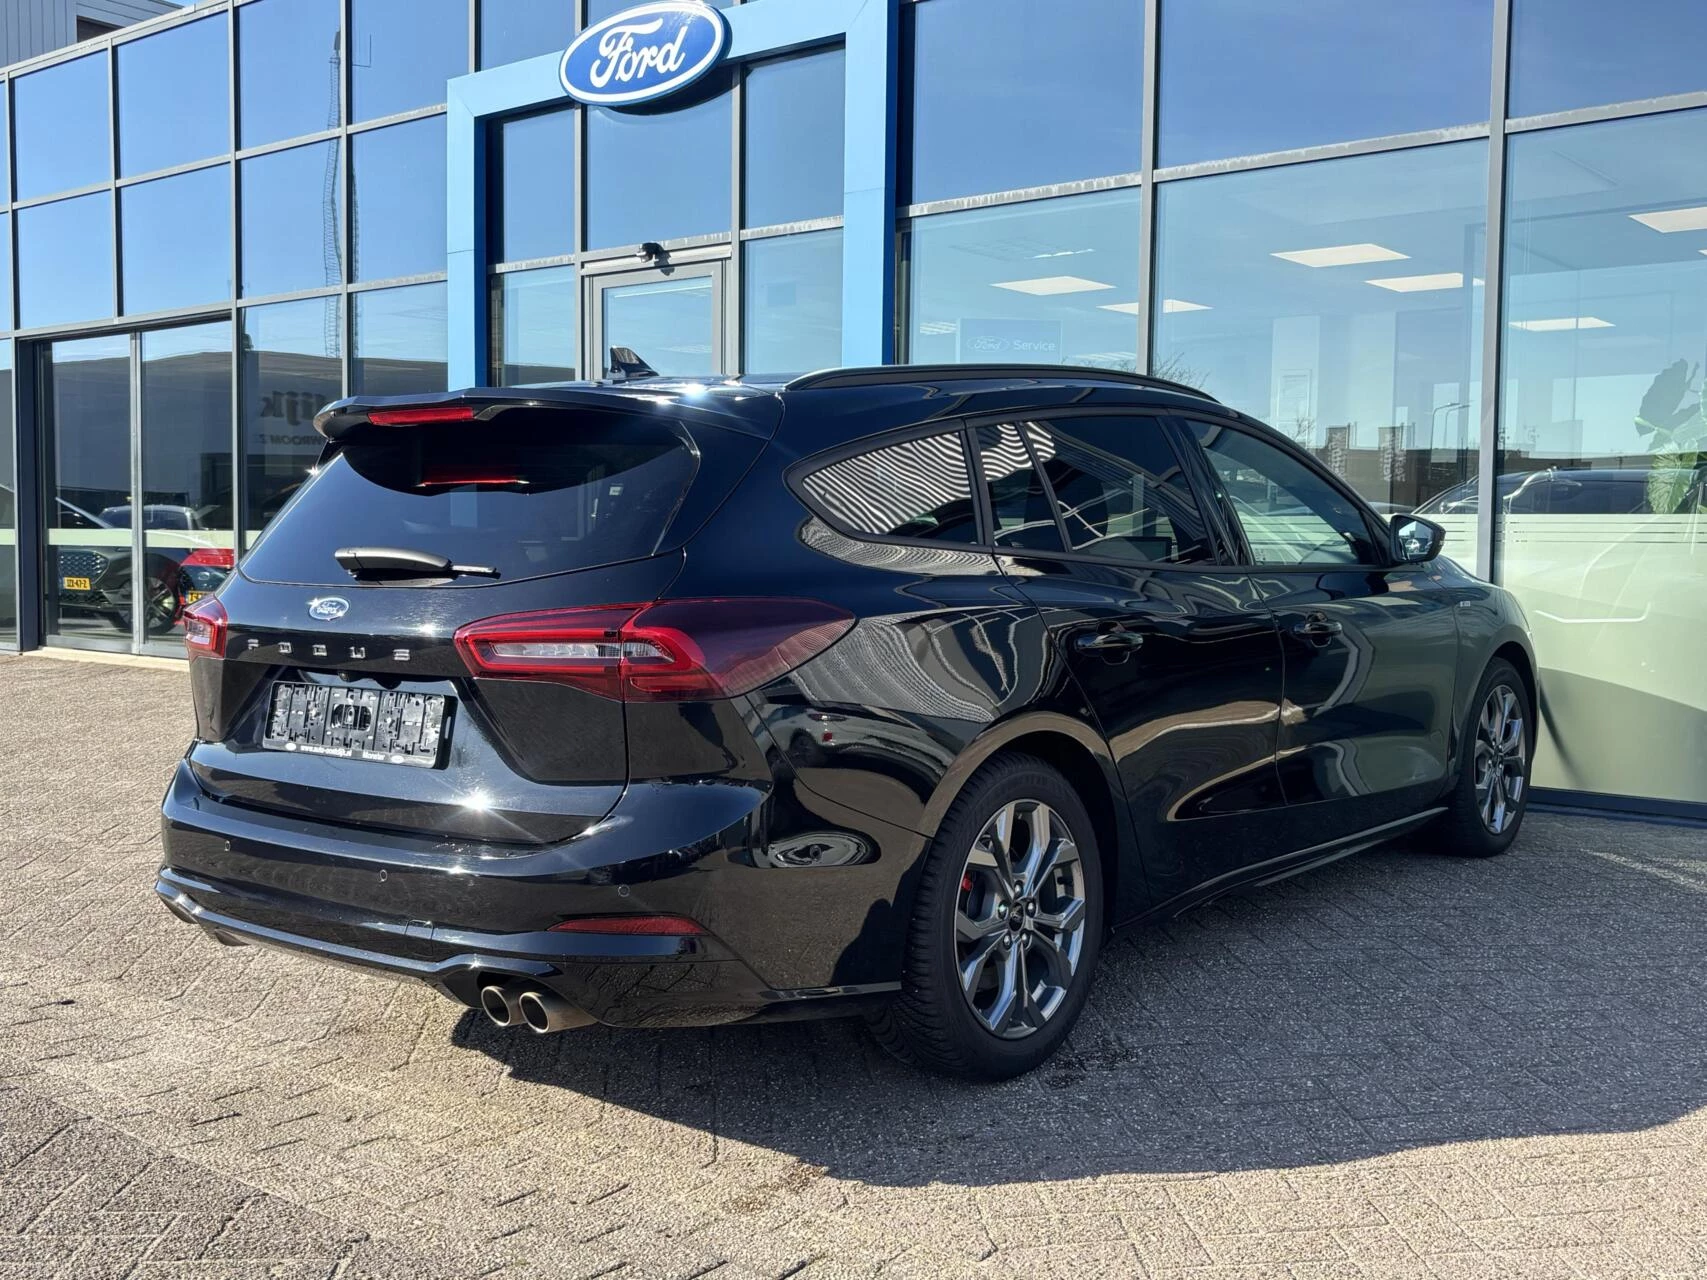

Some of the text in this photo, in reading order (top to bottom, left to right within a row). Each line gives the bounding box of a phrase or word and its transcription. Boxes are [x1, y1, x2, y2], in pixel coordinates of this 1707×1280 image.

[590, 18, 688, 88] Ford
[1013, 340, 1056, 352] Service
[248, 638, 410, 661] FOCUS
